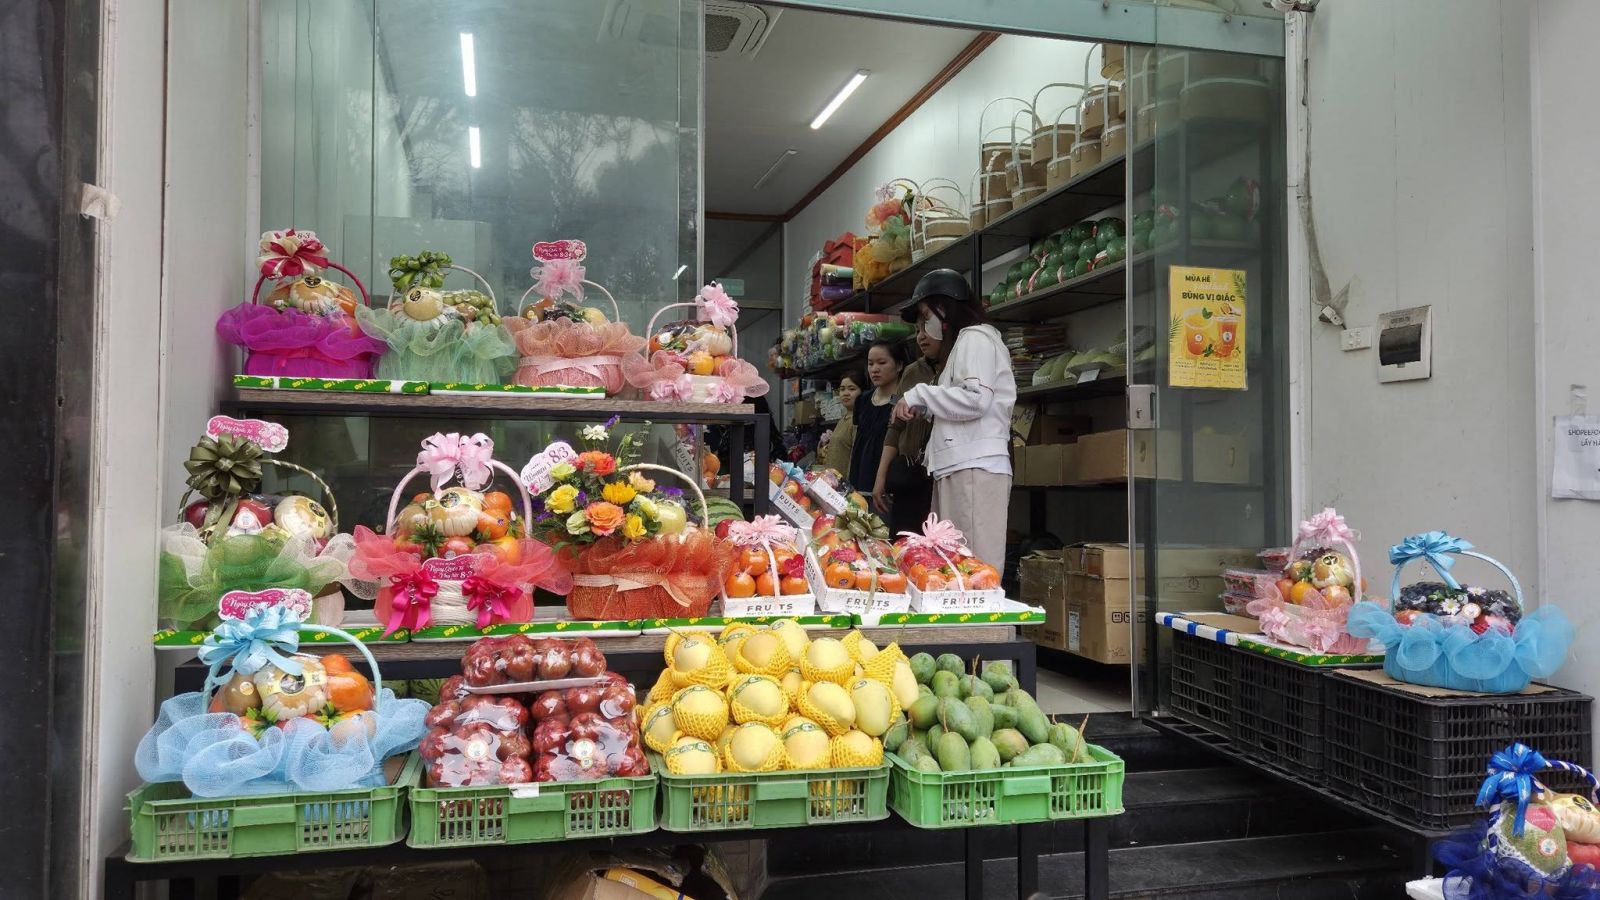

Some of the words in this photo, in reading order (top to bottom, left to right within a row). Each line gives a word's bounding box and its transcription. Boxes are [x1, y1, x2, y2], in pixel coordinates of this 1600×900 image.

[1185, 274, 1201, 282] MÙA
[1206, 293, 1215, 302] VỊ
[779, 494, 800, 514] RUITS
[747, 603, 793, 612] FRUTS
